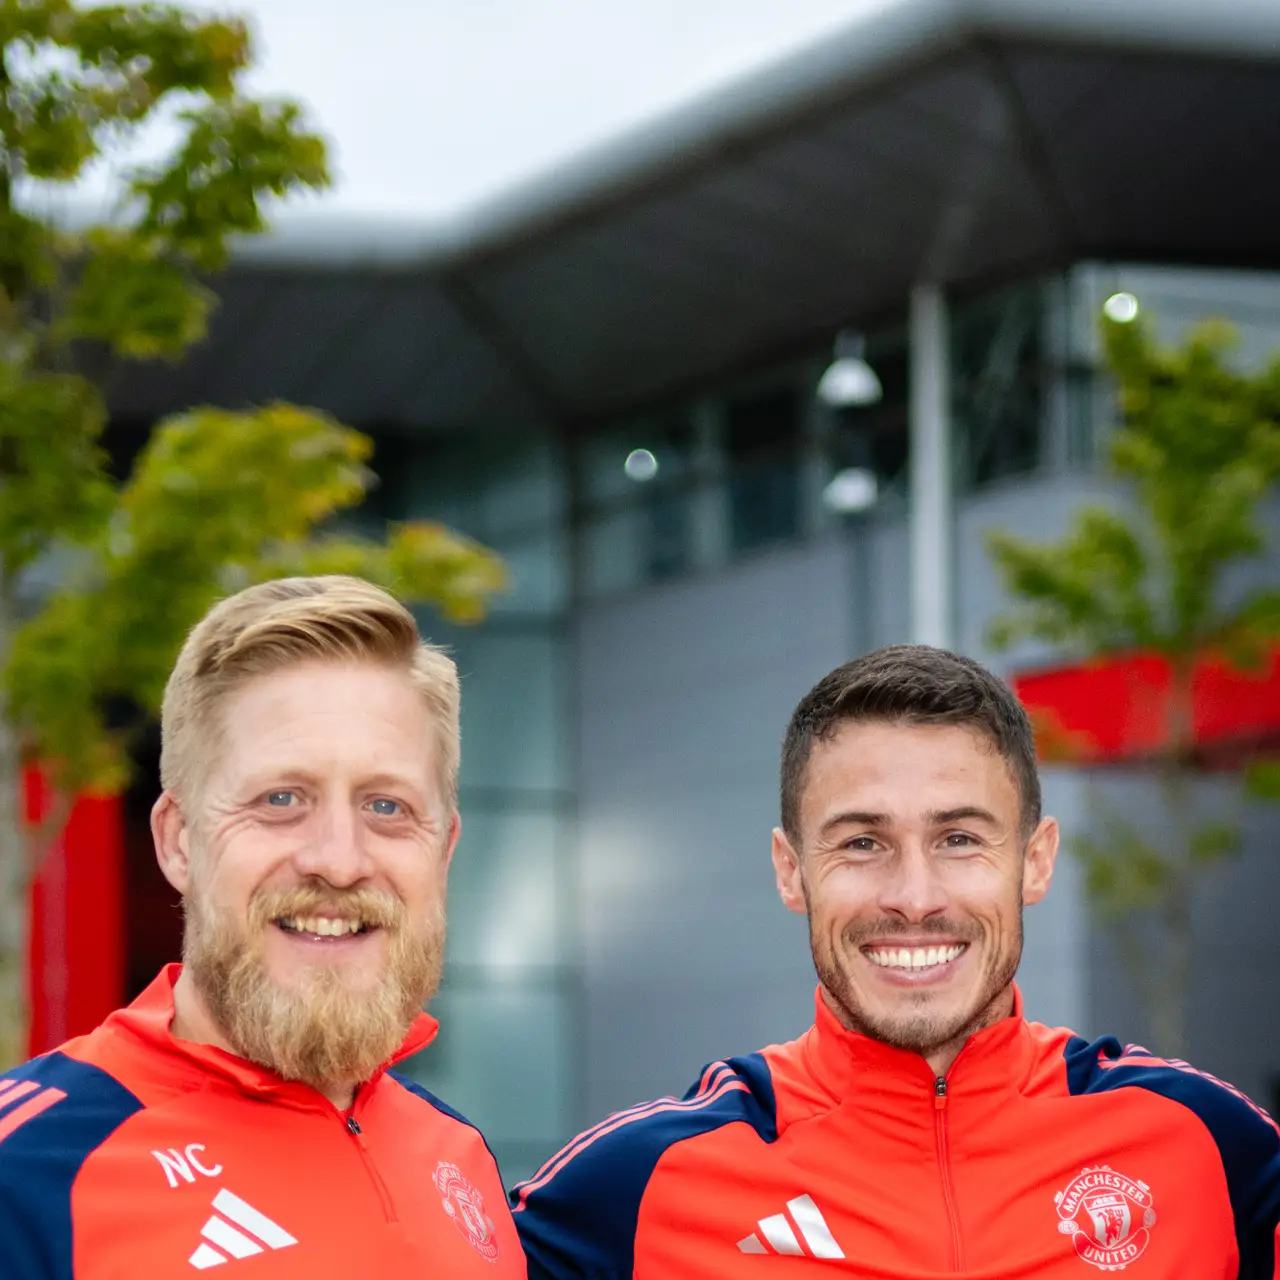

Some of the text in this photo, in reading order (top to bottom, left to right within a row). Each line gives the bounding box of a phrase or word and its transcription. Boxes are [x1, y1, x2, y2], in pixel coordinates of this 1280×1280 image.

[150, 1143, 223, 1188] NC
[1063, 1174, 1145, 1213] MANCHESTER
[1084, 1243, 1138, 1264] UNITED
